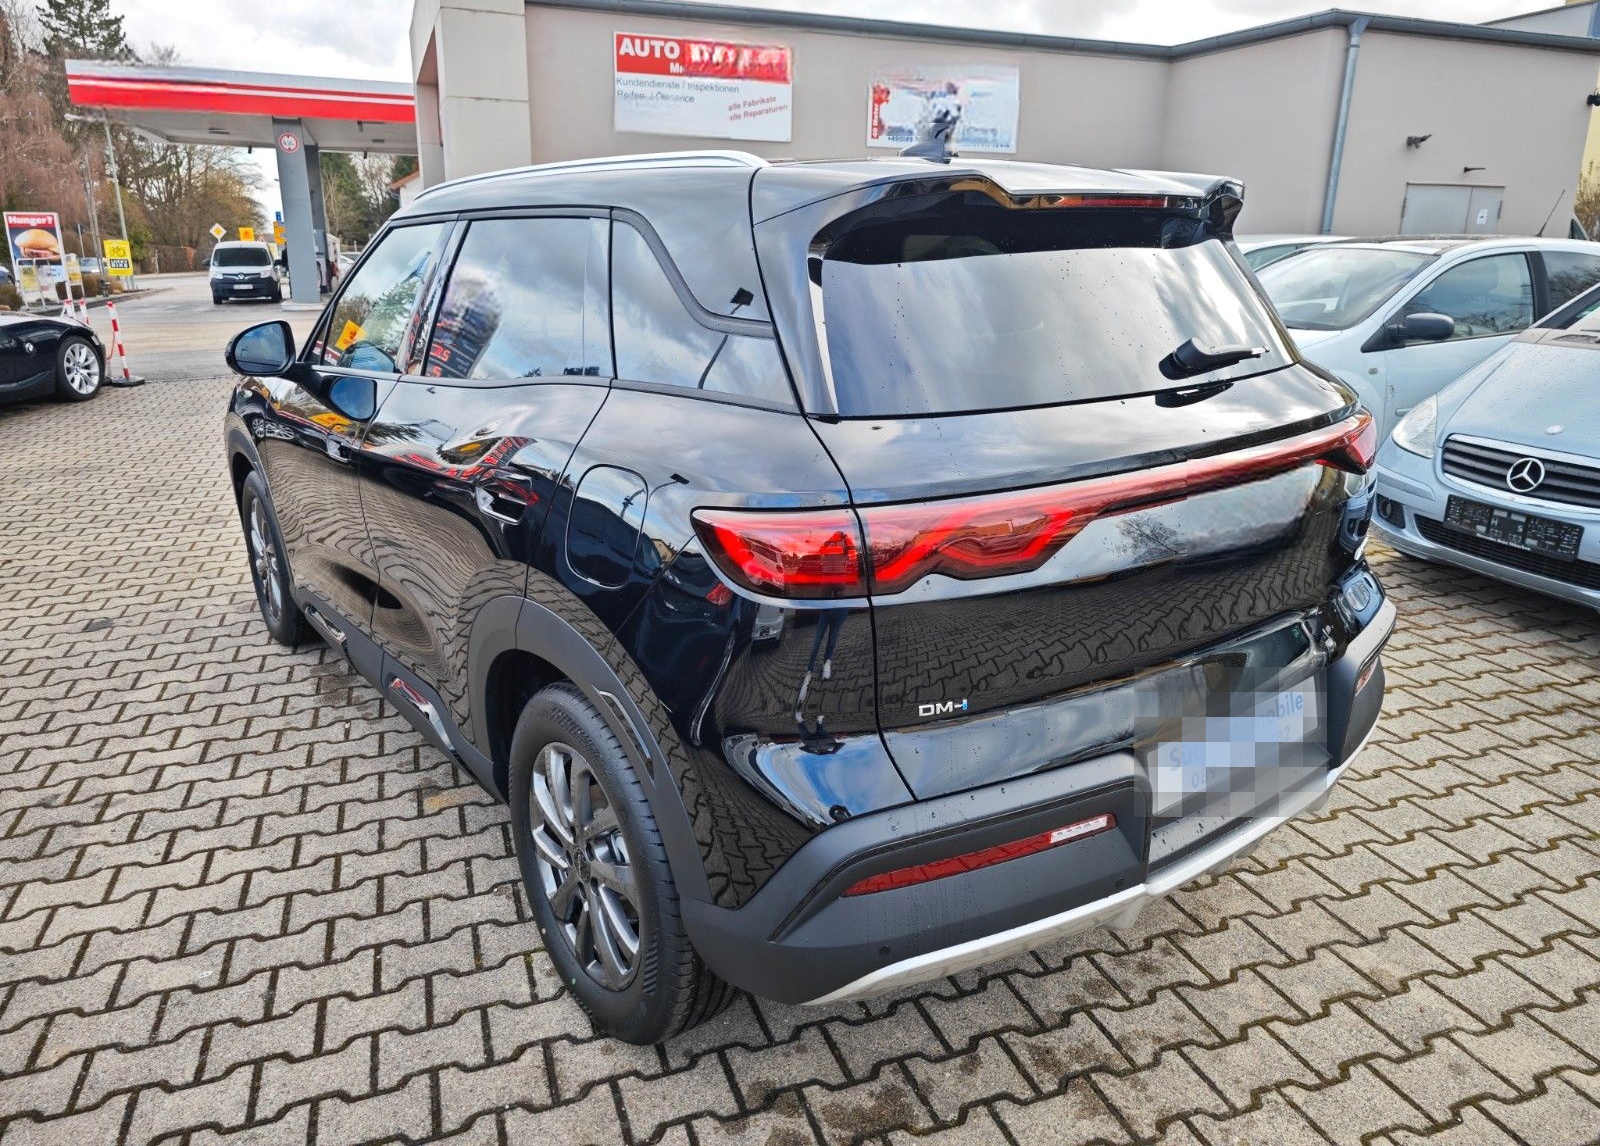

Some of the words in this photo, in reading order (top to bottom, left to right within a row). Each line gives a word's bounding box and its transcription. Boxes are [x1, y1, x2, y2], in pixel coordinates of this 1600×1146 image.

[619, 37, 680, 60] AUTO
[616, 77, 680, 90] Kundendienste
[688, 82, 740, 94] Inspektionen
[743, 95, 777, 107] Fabrikate
[743, 104, 788, 118] Reparaturen
[8, 215, 53, 226] Hunger?
